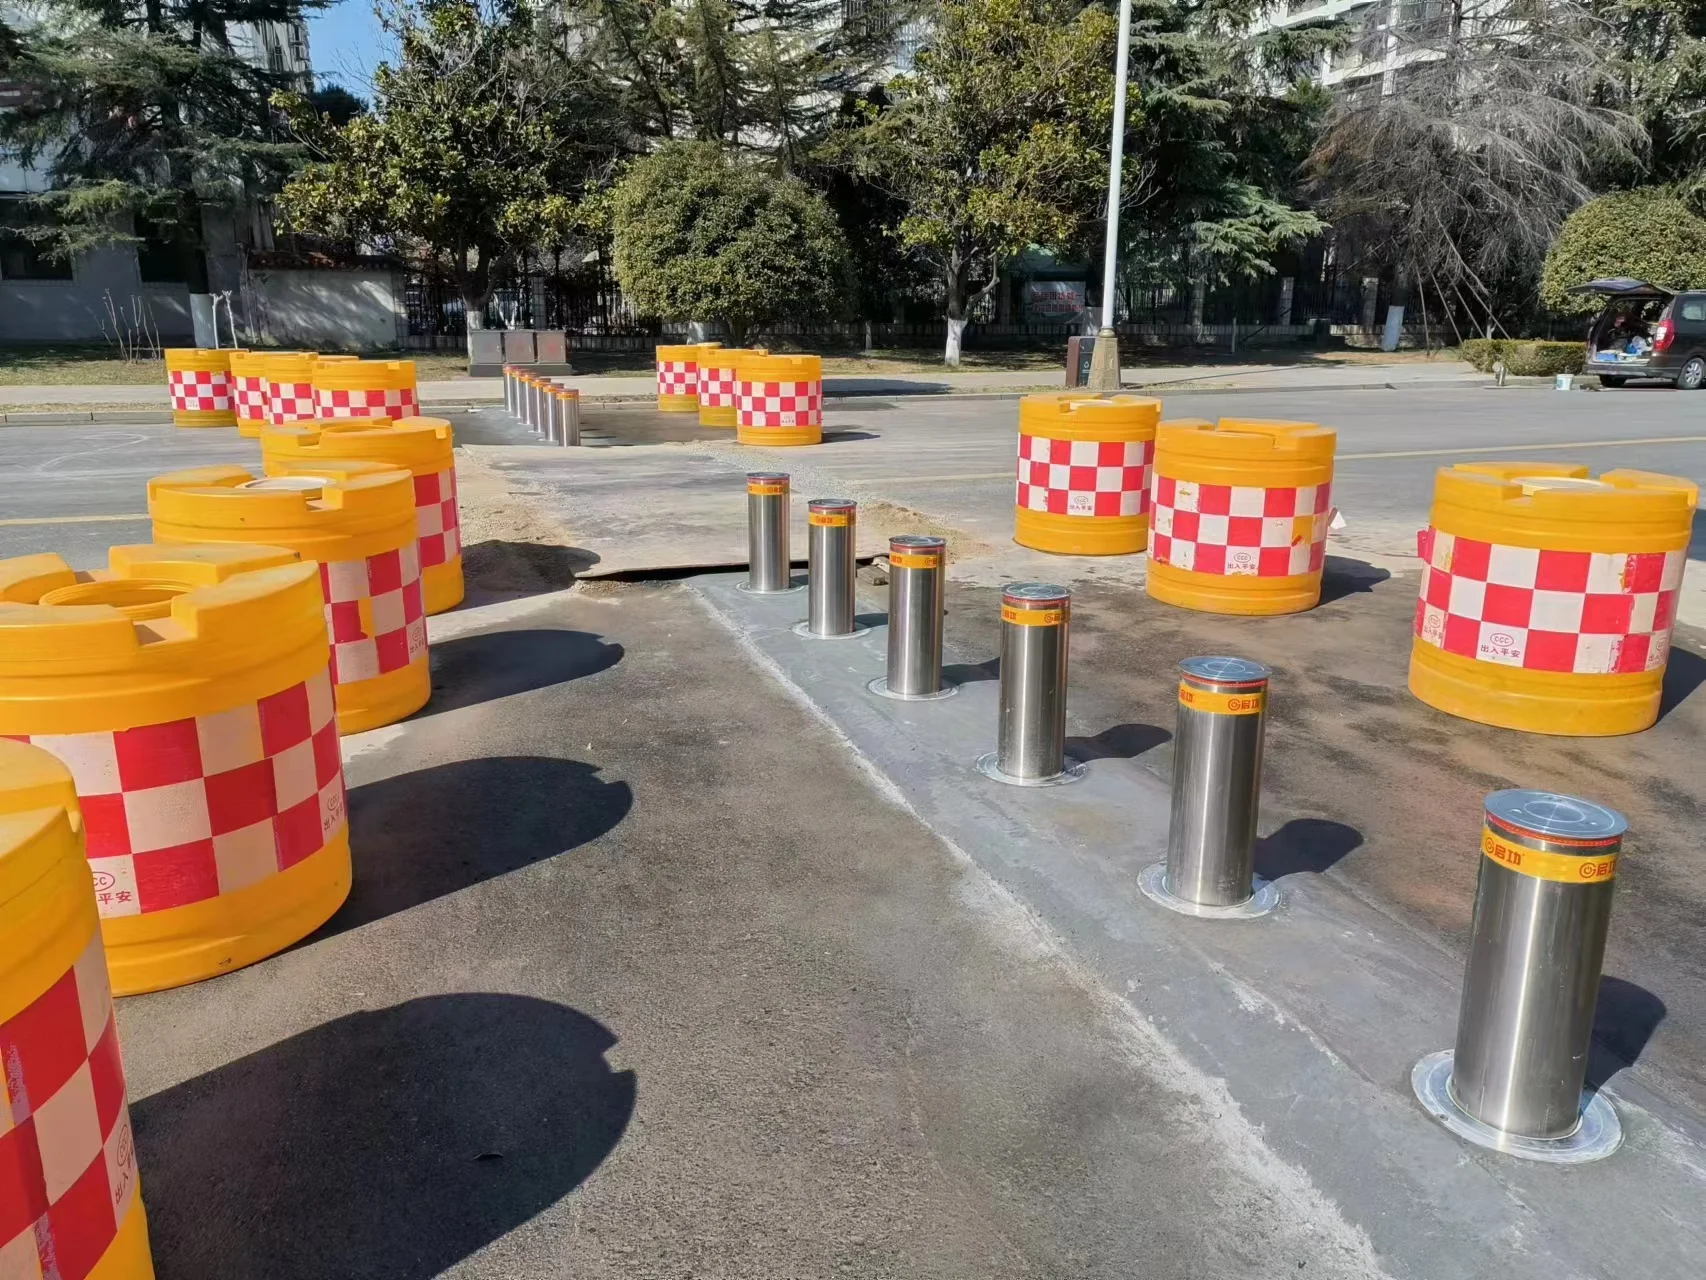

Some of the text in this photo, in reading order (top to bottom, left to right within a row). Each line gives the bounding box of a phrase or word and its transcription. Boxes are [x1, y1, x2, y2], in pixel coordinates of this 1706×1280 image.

[1480, 644, 1520, 659] 出入平安
[98, 890, 132, 905] 平安
